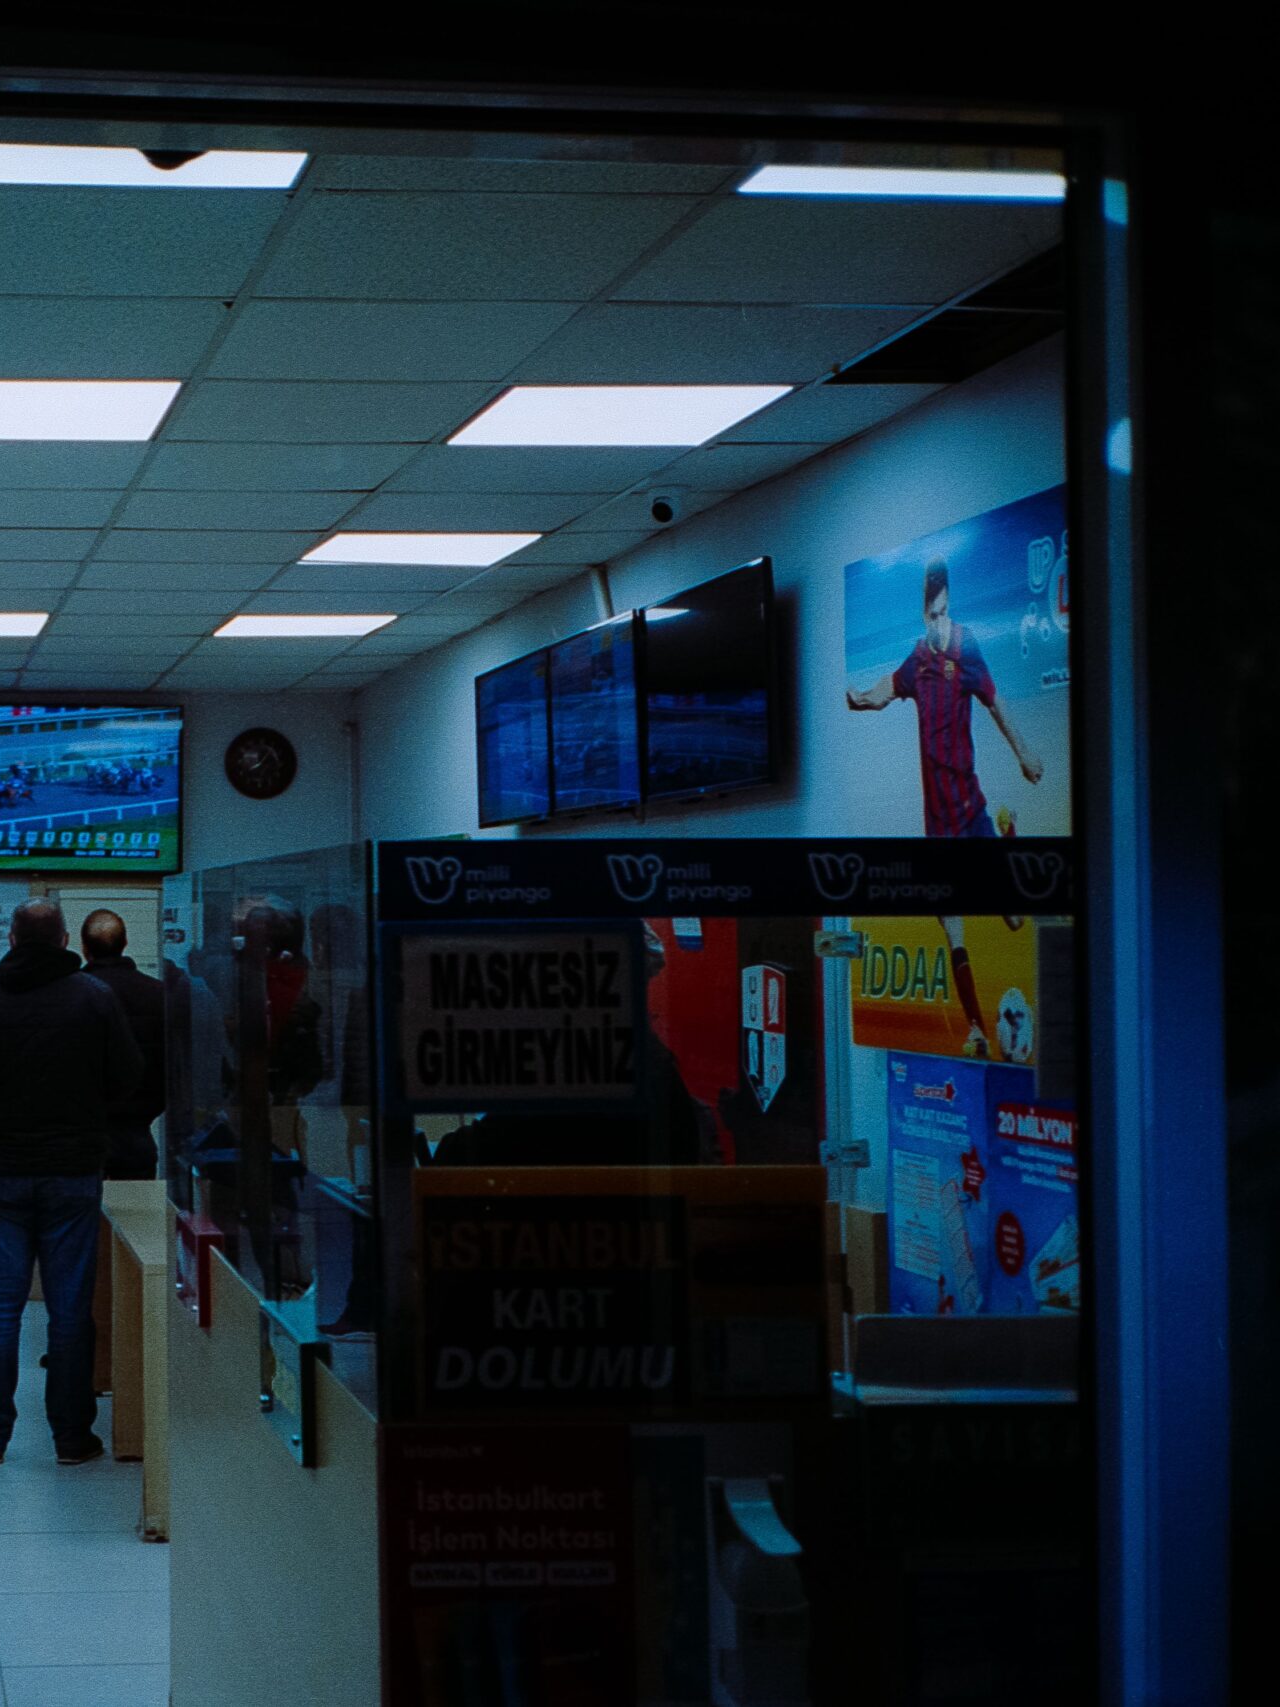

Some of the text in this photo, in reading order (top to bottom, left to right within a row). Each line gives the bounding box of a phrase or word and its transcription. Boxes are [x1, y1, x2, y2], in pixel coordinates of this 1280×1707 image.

[466, 863, 510, 882] milli
[667, 862, 711, 881] milli
[868, 860, 913, 879] milli
[466, 884, 552, 904] piyango
[667, 882, 752, 903] piyango
[868, 880, 953, 902] piyango
[431, 938, 620, 1009] MASKESİZ
[860, 932, 950, 1003] İDDAA
[418, 1014, 635, 1085] GİRMEYİNİZ
[998, 1110, 1015, 1135] 20
[1017, 1107, 1073, 1144] MİLYON
[491, 1287, 615, 1330] KART
[433, 1344, 677, 1392] DOLUMU
[414, 1475, 608, 1512] İstanbulkart
[405, 1513, 617, 1555] İşlem Noktası
